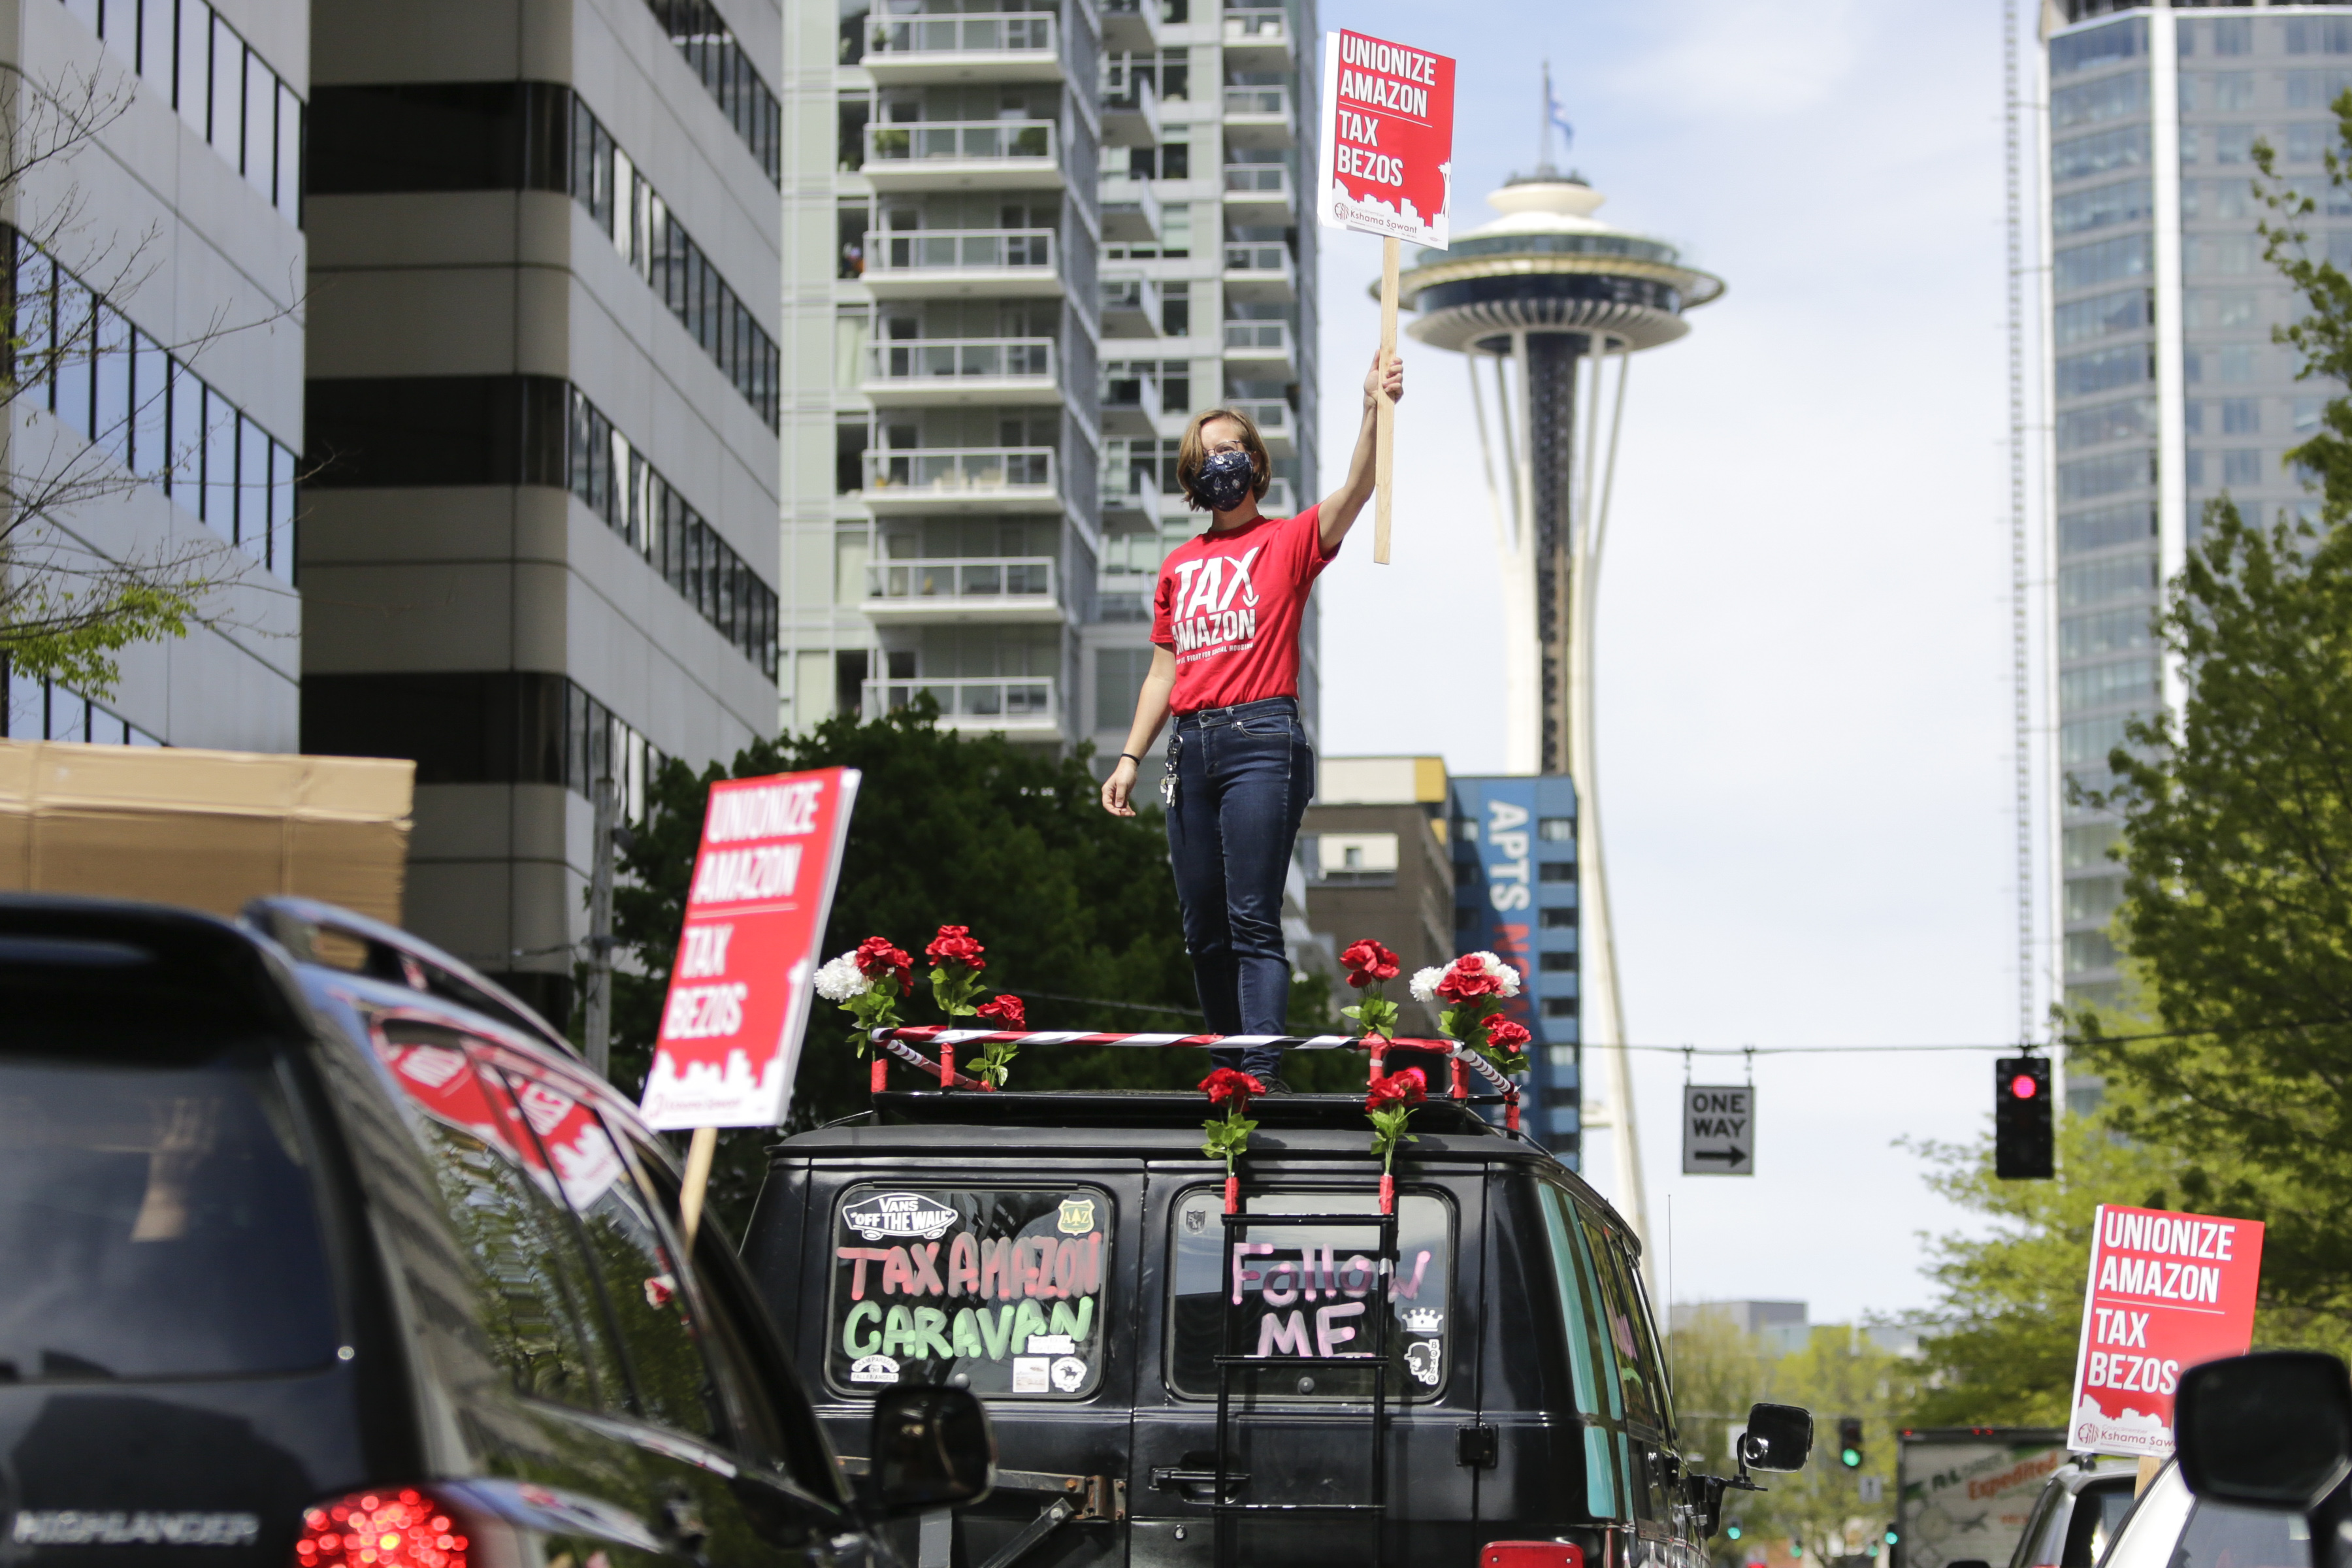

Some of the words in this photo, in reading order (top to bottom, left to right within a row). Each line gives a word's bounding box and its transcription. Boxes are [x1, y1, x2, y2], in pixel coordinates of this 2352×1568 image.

[1341, 34, 1437, 86] UNIONIZE
[1340, 69, 1428, 118] AMAZON
[1339, 110, 1379, 147] TAX
[1337, 144, 1403, 187] BEZOS
[1350, 210, 1384, 225] Kshama
[1386, 220, 1417, 234] Sawant
[1174, 546, 1260, 622] TAX
[1171, 608, 1256, 655] AMAZON
[1187, 653, 1201, 662] FIGHT
[1212, 646, 1228, 655] SOCIAL
[706, 780, 824, 843] UNIONIZE
[691, 843, 804, 904] AMAZON
[1488, 800, 1531, 911] APTS
[680, 923, 734, 979] TAX
[662, 982, 748, 1040] BEZOS
[1692, 1093, 1746, 1113] ONE
[1693, 1118, 1747, 1137] WAY
[879, 1197, 919, 1213] VANS
[881, 1212, 910, 1231] THE
[2104, 1211, 2236, 1262] UNIONIZE
[836, 1242, 944, 1301] TAX
[948, 1231, 1102, 1301] AMAZON
[2098, 1255, 2220, 1303] AMAZON
[843, 1296, 1094, 1360] CARAVAN
[1258, 1302, 1376, 1358] ME
[2095, 1307, 2150, 1348] TAX
[2087, 1351, 2179, 1396] BEZOS
[2100, 1429, 2146, 1445] Kshama
